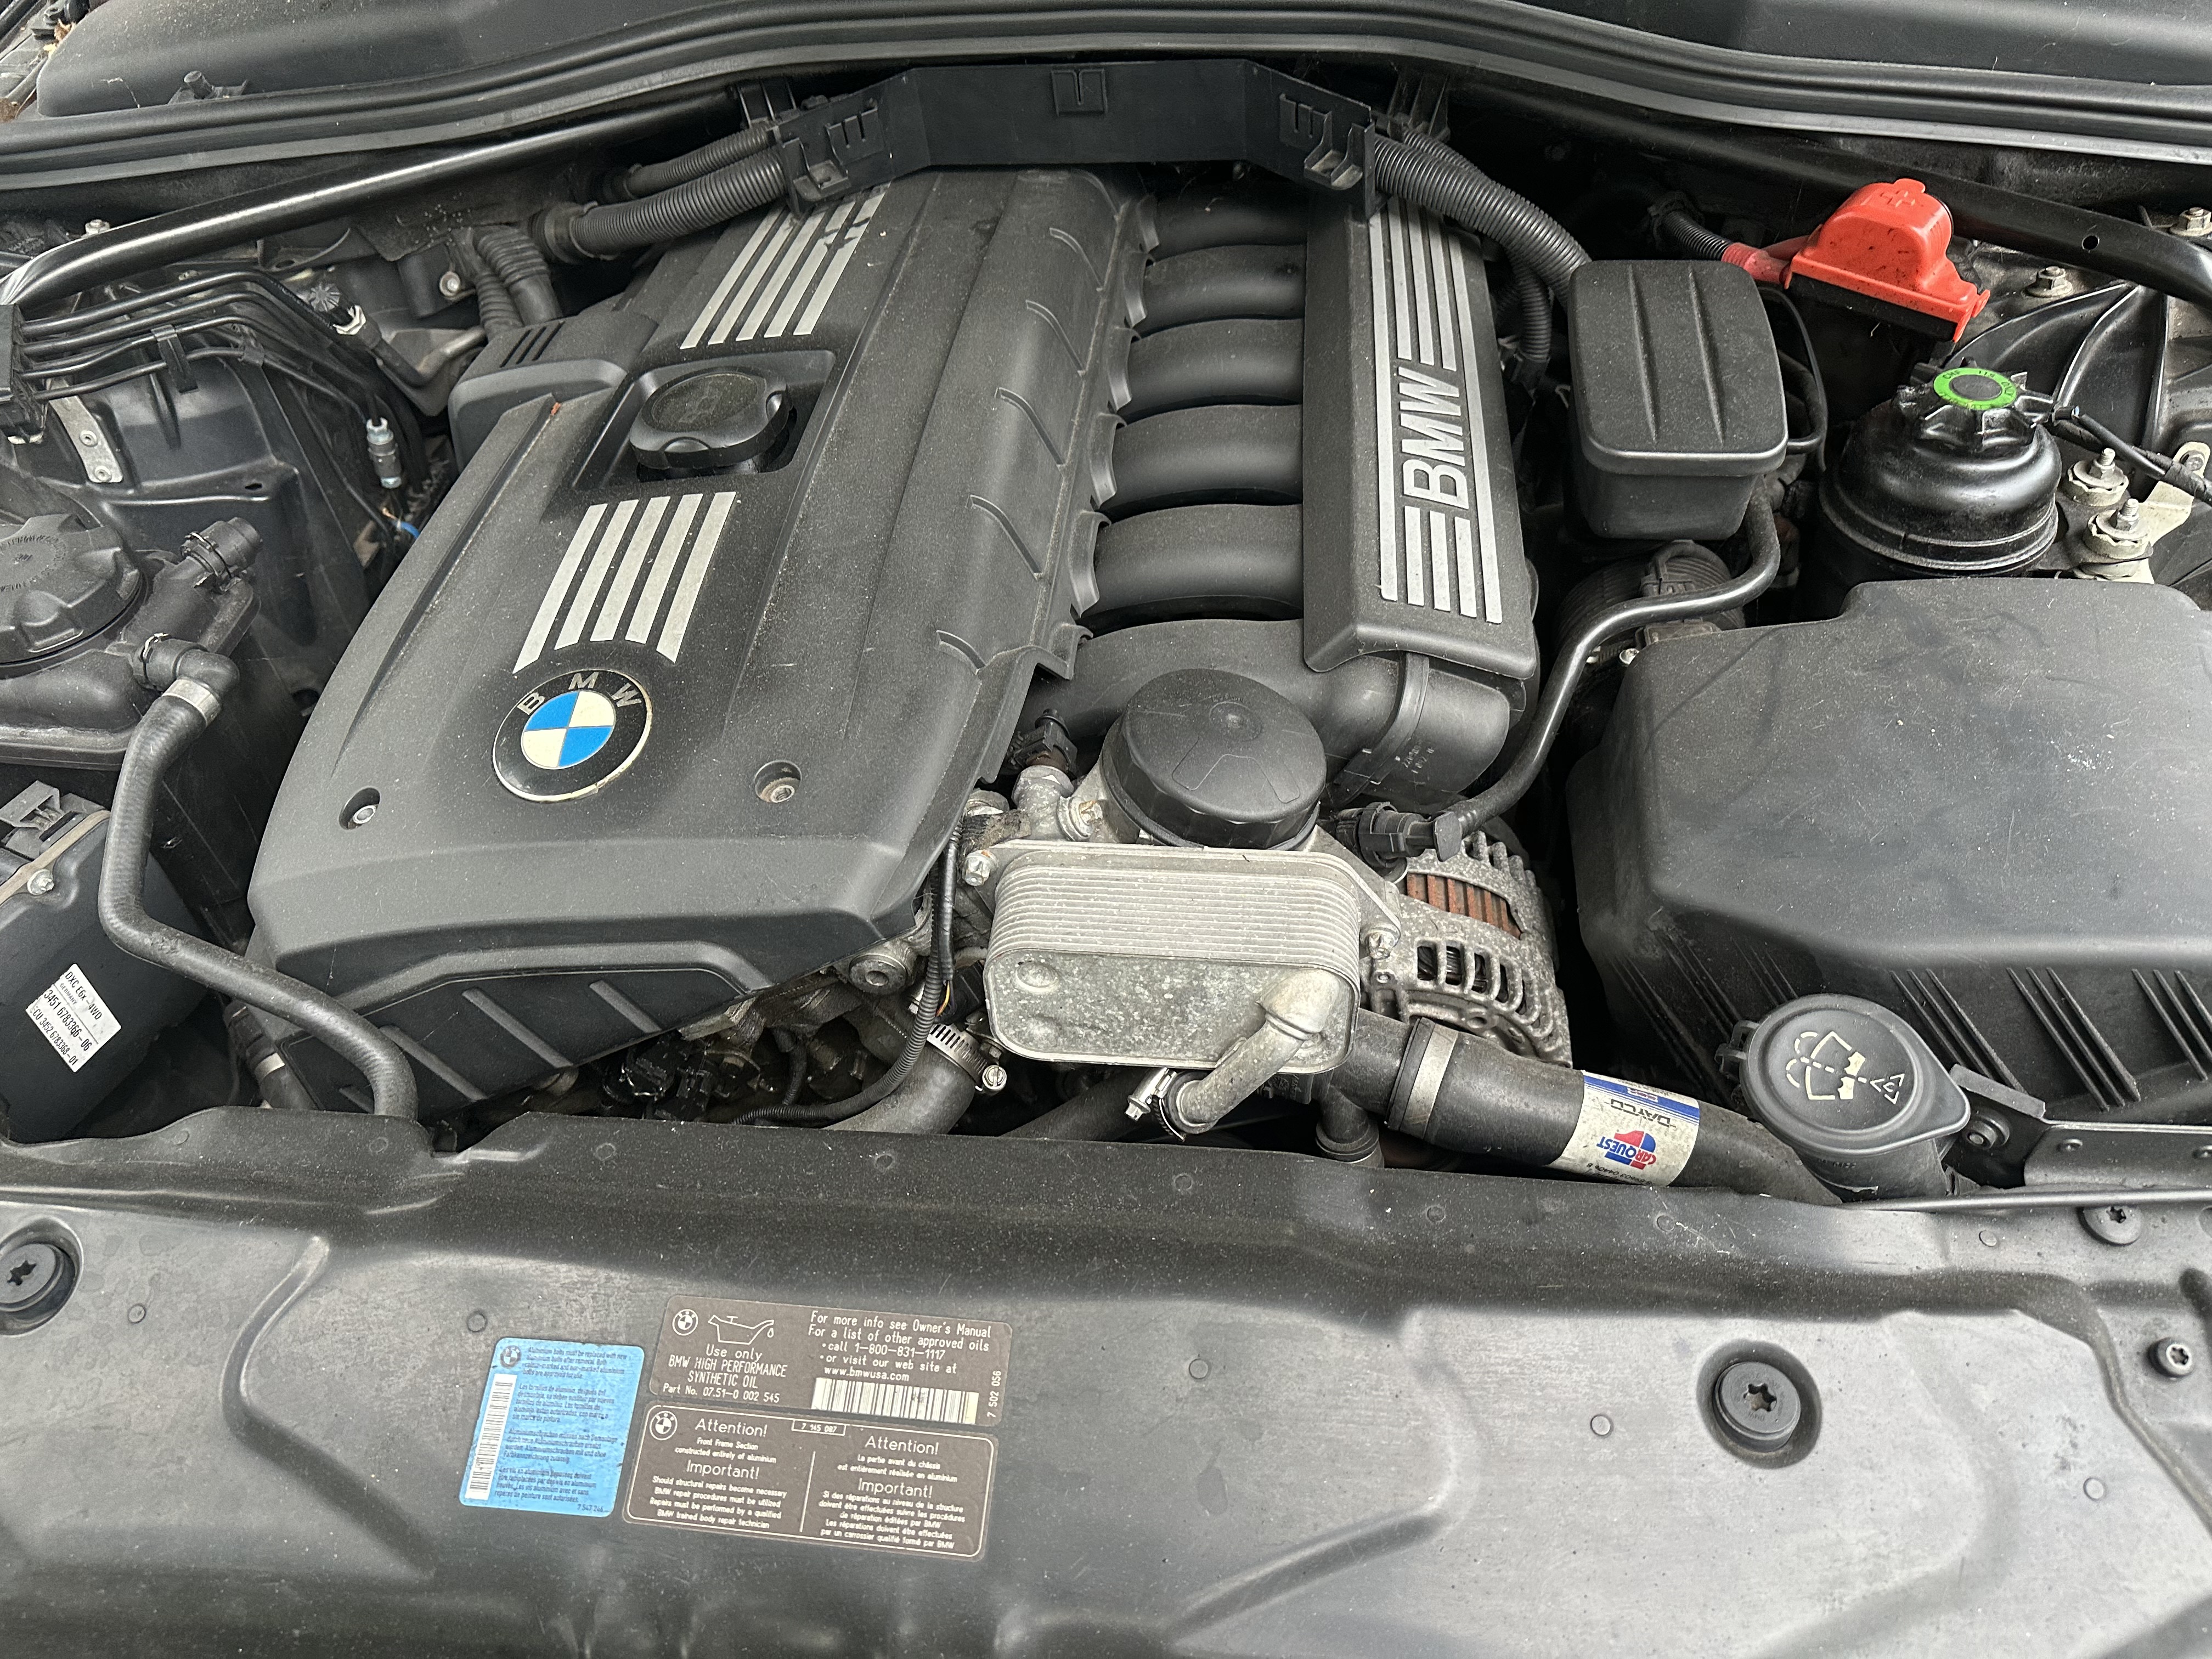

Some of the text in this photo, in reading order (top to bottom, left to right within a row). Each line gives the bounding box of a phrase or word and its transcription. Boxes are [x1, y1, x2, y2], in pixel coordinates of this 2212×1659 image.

[1398, 366, 1469, 510] BMW
[517, 672, 642, 715] BMW
[65, 972, 80, 988] DXC
[60, 983, 77, 1005] GERMANY
[44, 990, 92, 1051] 3451 6783366-06
[40, 1018, 53, 1034] 3452
[50, 1031, 78, 1065] 6783368-01
[1611, 1099, 1671, 1127] DAYCO
[1596, 1136, 1656, 1165] CARQUEST
[811, 1310, 991, 1337] For more info see Owner's Manual
[809, 1323, 989, 1351] For a list of other approved oils
[706, 1343, 763, 1361] Use only
[828, 1340, 945, 1359] call 1-800-831-1117
[669, 1354, 788, 1376] BMW HIGH PERFORMANCE
[825, 1365, 909, 1381] www.bmwusa.com
[843, 1355, 867, 1364] visit
[895, 1359, 913, 1369] web
[920, 1361, 940, 1372] site
[946, 1363, 956, 1373] at
[688, 1370, 758, 1388] SYNTHETIC OIL
[991, 1370, 1002, 1386] 056
[663, 1383, 780, 1402] Part No. 07.51-0 002 545
[989, 1391, 999, 1408] 502
[695, 1418, 768, 1437] Attention!
[865, 1435, 939, 1454] Attention!
[686, 1459, 759, 1479] Important!
[859, 1477, 933, 1498] Important!
